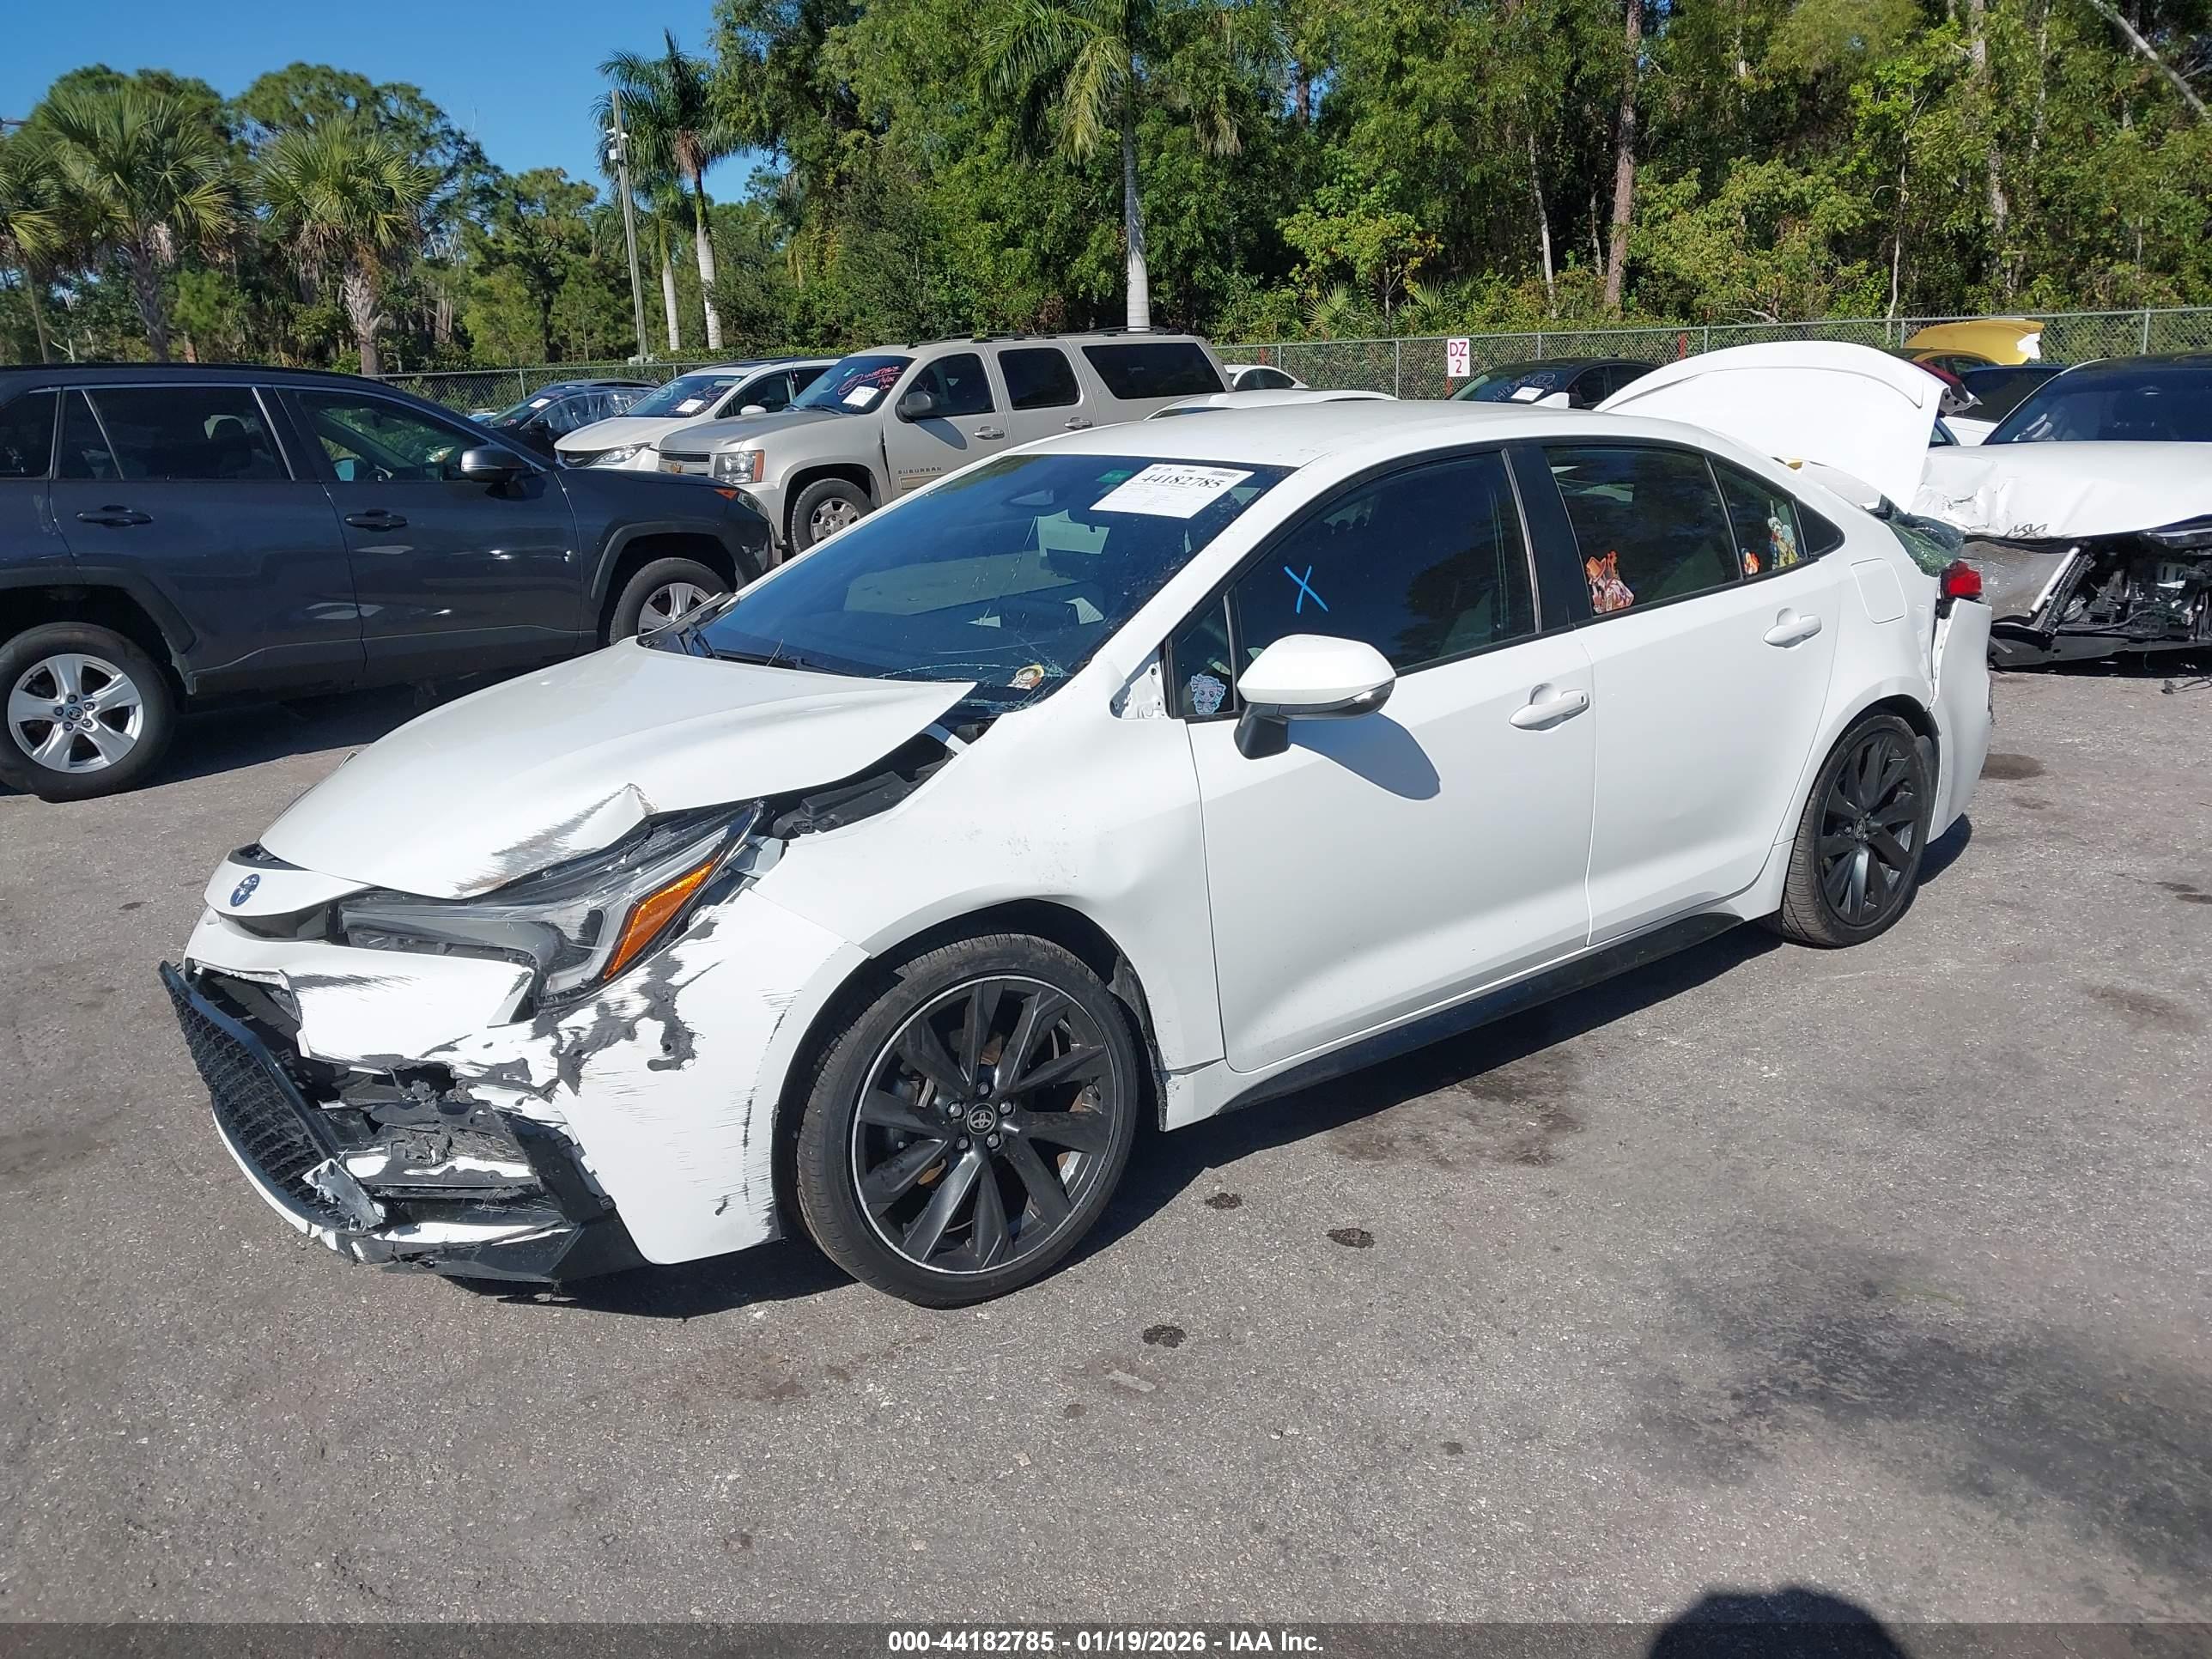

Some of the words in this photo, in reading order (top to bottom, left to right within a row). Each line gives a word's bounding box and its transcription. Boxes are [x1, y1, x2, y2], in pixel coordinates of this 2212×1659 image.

[1449, 342, 1468, 356] DZ
[1455, 359, 1462, 374] 2
[1141, 473, 1226, 489] 44182785
